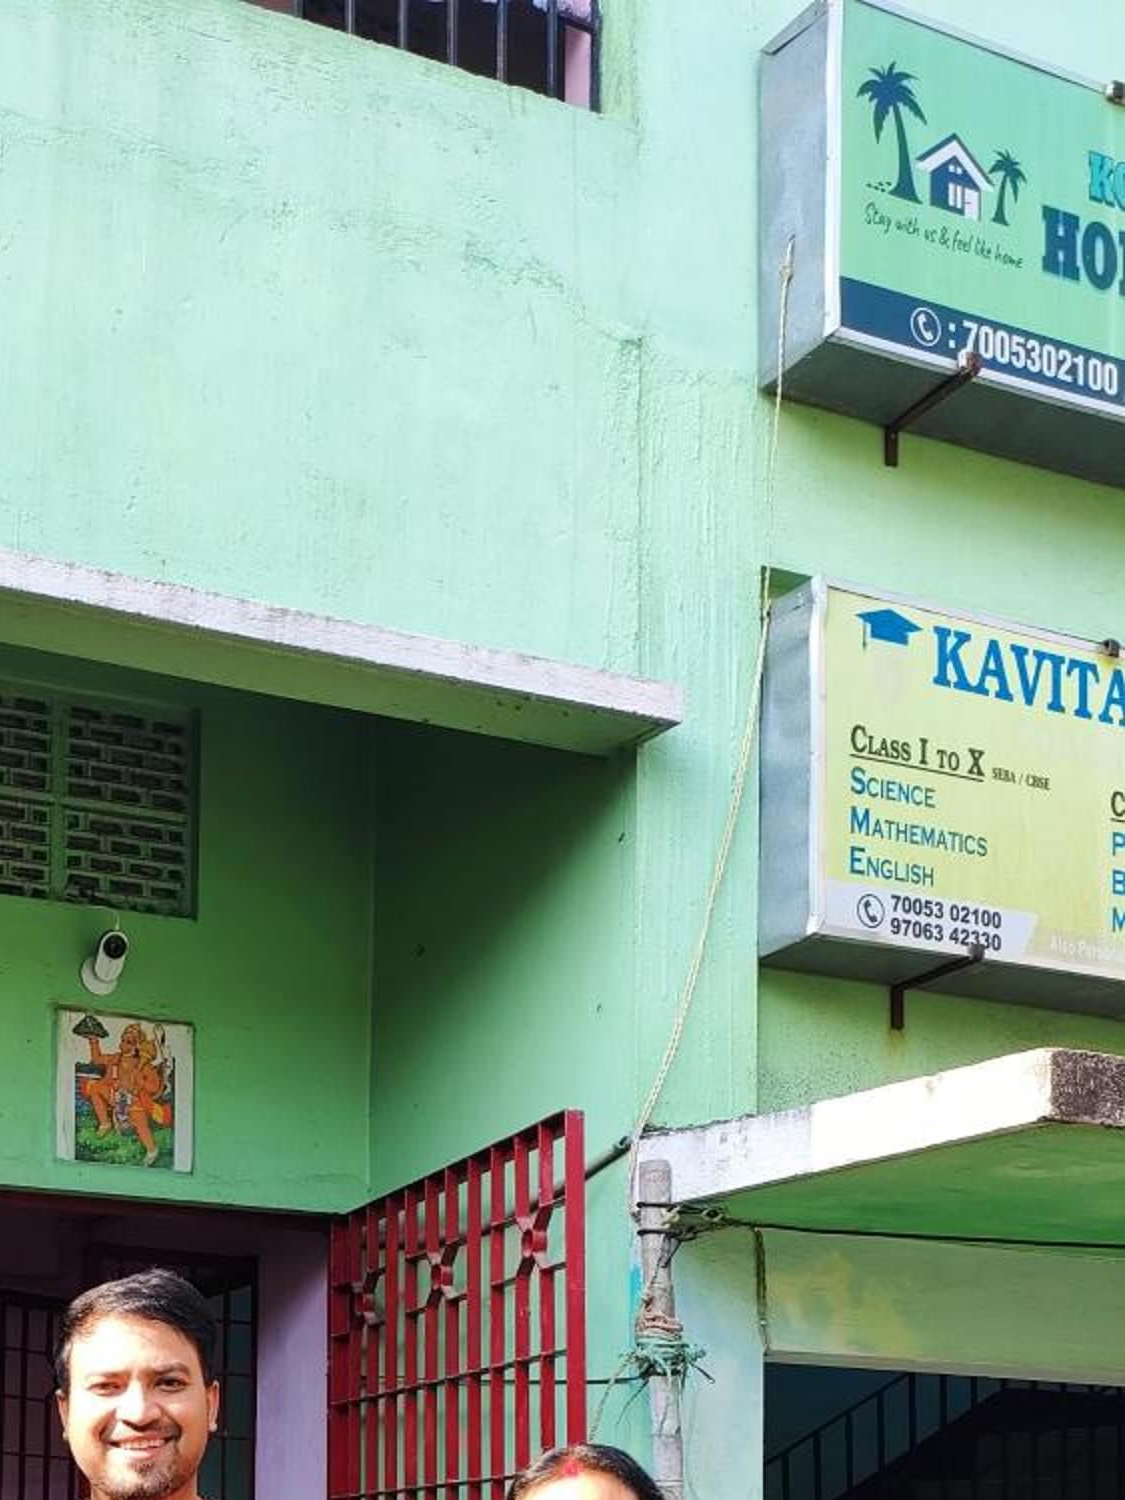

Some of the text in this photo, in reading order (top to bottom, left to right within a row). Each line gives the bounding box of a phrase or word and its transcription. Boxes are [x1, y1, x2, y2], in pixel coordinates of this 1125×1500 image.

[865, 201, 1024, 268] Stay with us & feel like home
[1042, 204, 1125, 297] HO
[962, 319, 1118, 396] 7005302100
[932, 625, 1125, 727] KAVITA
[850, 766, 936, 808] SCIENCE
[919, 737, 929, 765] I
[968, 748, 985, 777] X
[992, 767, 1016, 784] SEBA
[1025, 774, 1051, 790] CBSE
[850, 806, 988, 857] MATHEMATICS
[849, 846, 935, 887] ENGLISH
[890, 894, 1002, 929] 70053 02100
[890, 917, 1002, 951] 97063 42330
